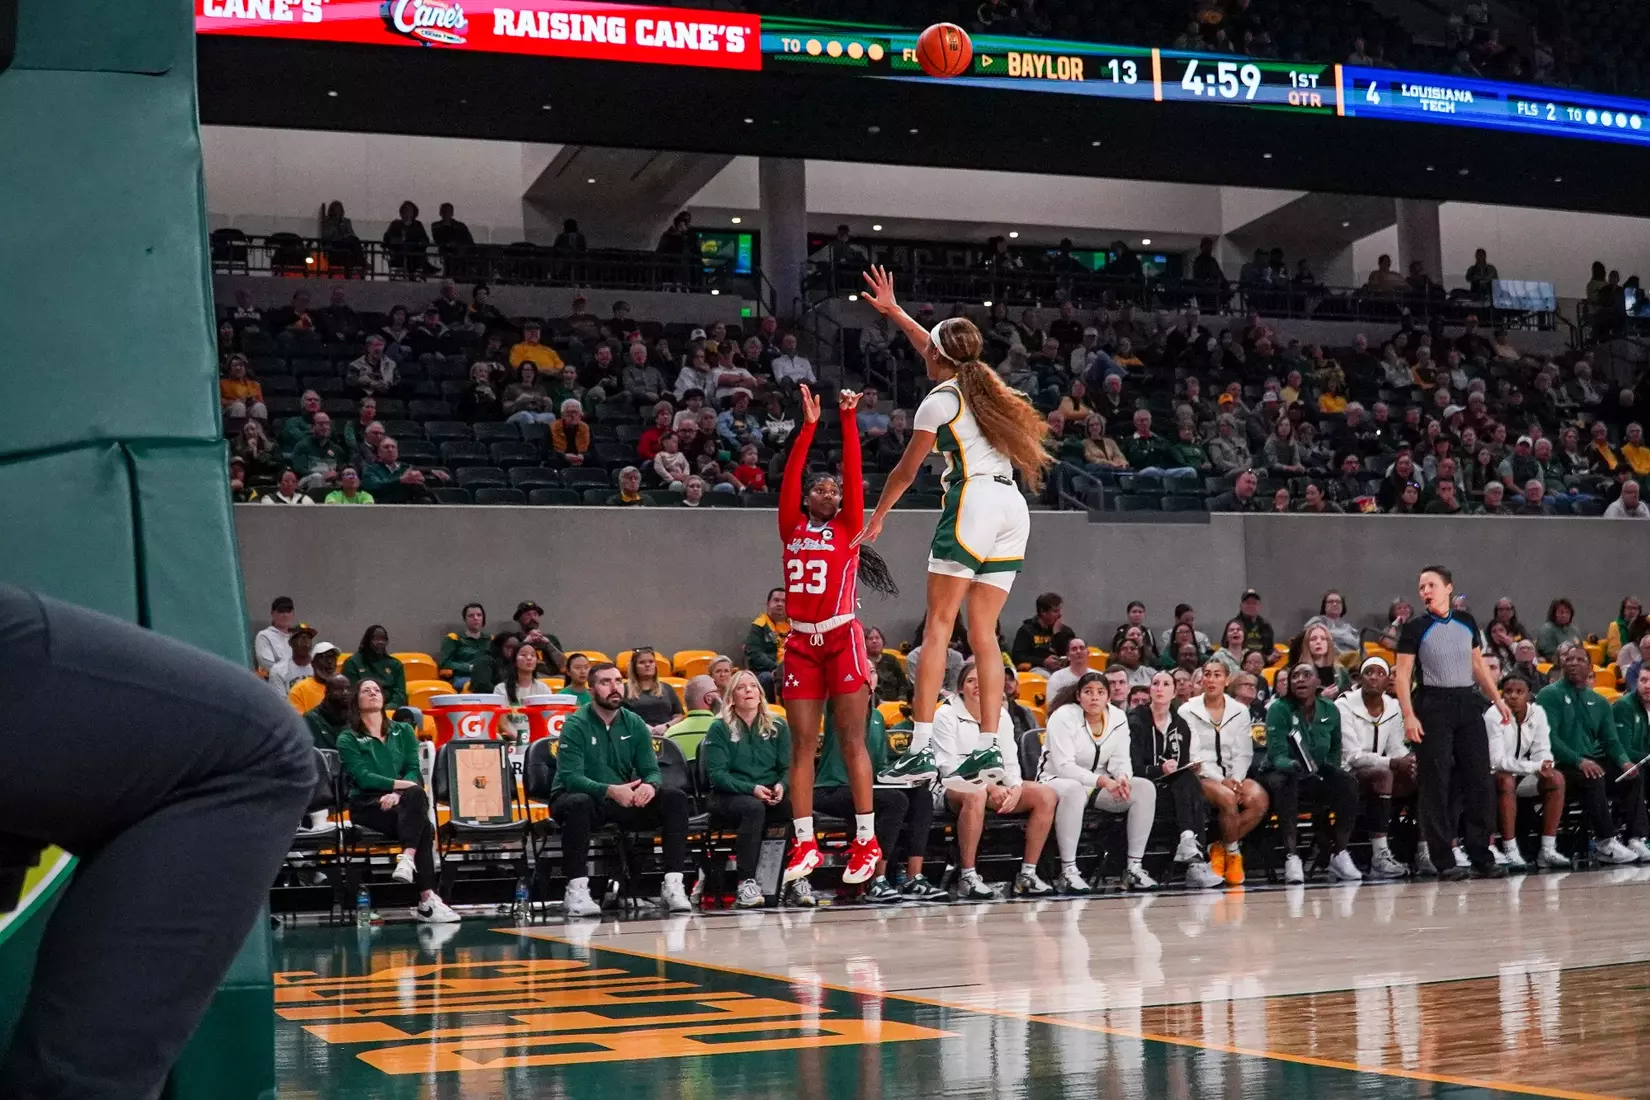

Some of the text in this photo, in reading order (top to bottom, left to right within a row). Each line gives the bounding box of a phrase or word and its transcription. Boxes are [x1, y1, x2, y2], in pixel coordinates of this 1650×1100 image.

[203, 0, 322, 23] CANE'S
[493, 8, 746, 53] RAISING CANE'S
[781, 38, 801, 53] TO
[902, 48, 919, 63] FL
[1007, 52, 1084, 81] BAYLOR
[1108, 59, 1138, 84] 13
[1181, 59, 1261, 100] 4:59
[1289, 70, 1319, 88] 1ST
[1288, 91, 1322, 107] QTR
[1366, 81, 1380, 104] 4
[1401, 83, 1474, 103] LOUISIANA
[1420, 99, 1456, 113] TECH
[1517, 101, 1556, 120] FLS 2
[1567, 107, 1582, 121] TO
[787, 559, 828, 594] 23
[461, 715, 481, 738] G
